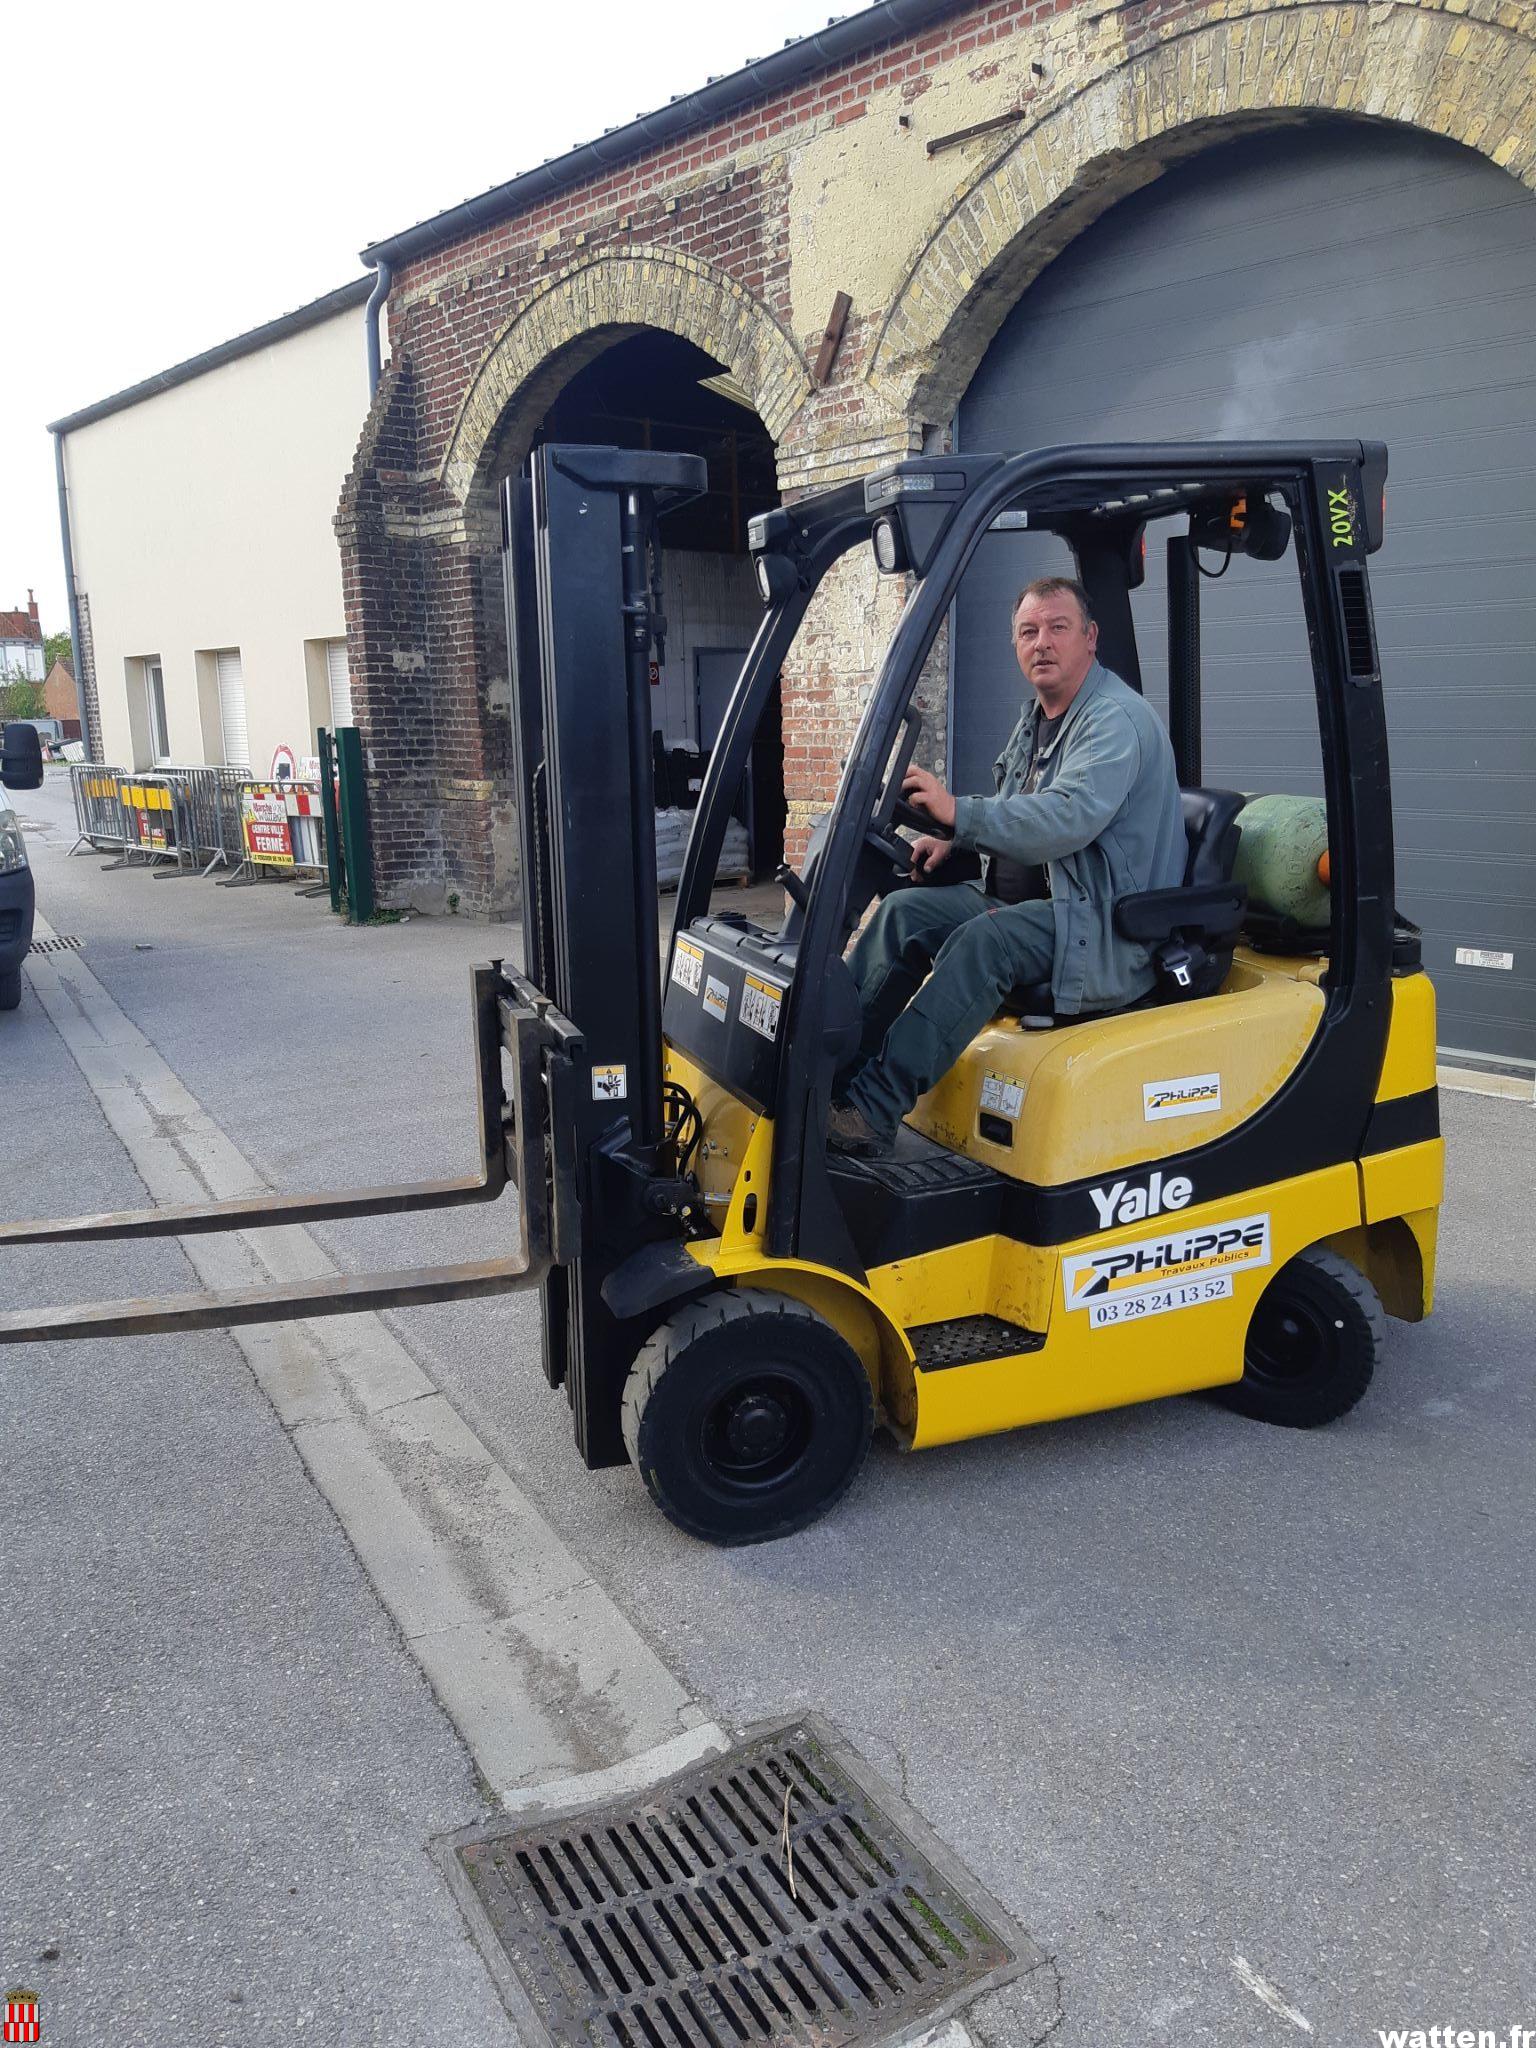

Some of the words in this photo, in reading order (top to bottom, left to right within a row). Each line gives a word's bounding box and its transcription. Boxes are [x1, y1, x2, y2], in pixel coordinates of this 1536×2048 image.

[1327, 488, 1353, 548] 20VX
[1088, 1171, 1193, 1229] Yale
[1160, 1261, 1205, 1277] Travaux
[1210, 1251, 1250, 1266] Publics
[1096, 1304, 1118, 1323] 03
[1124, 1299, 1146, 1317] 28
[1151, 1292, 1172, 1311] 24
[1180, 1286, 1199, 1304] 13
[1205, 1280, 1226, 1298] 52
